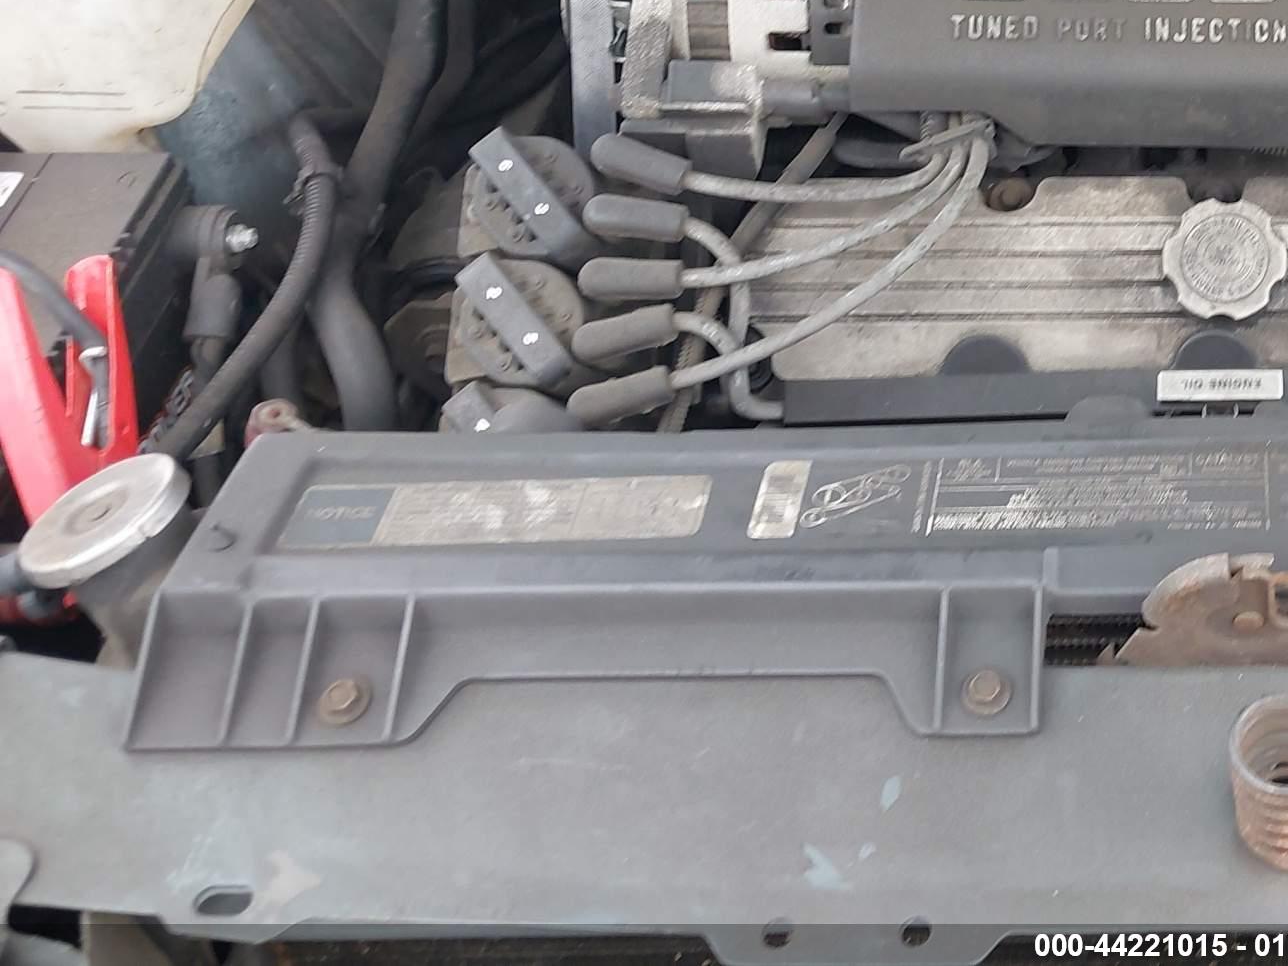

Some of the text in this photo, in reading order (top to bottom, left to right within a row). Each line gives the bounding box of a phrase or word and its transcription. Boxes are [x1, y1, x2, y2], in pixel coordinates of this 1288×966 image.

[950, 14, 1288, 44] TUNED PORT INJECTION
[1181, 377, 1263, 391] ENGINE OIL
